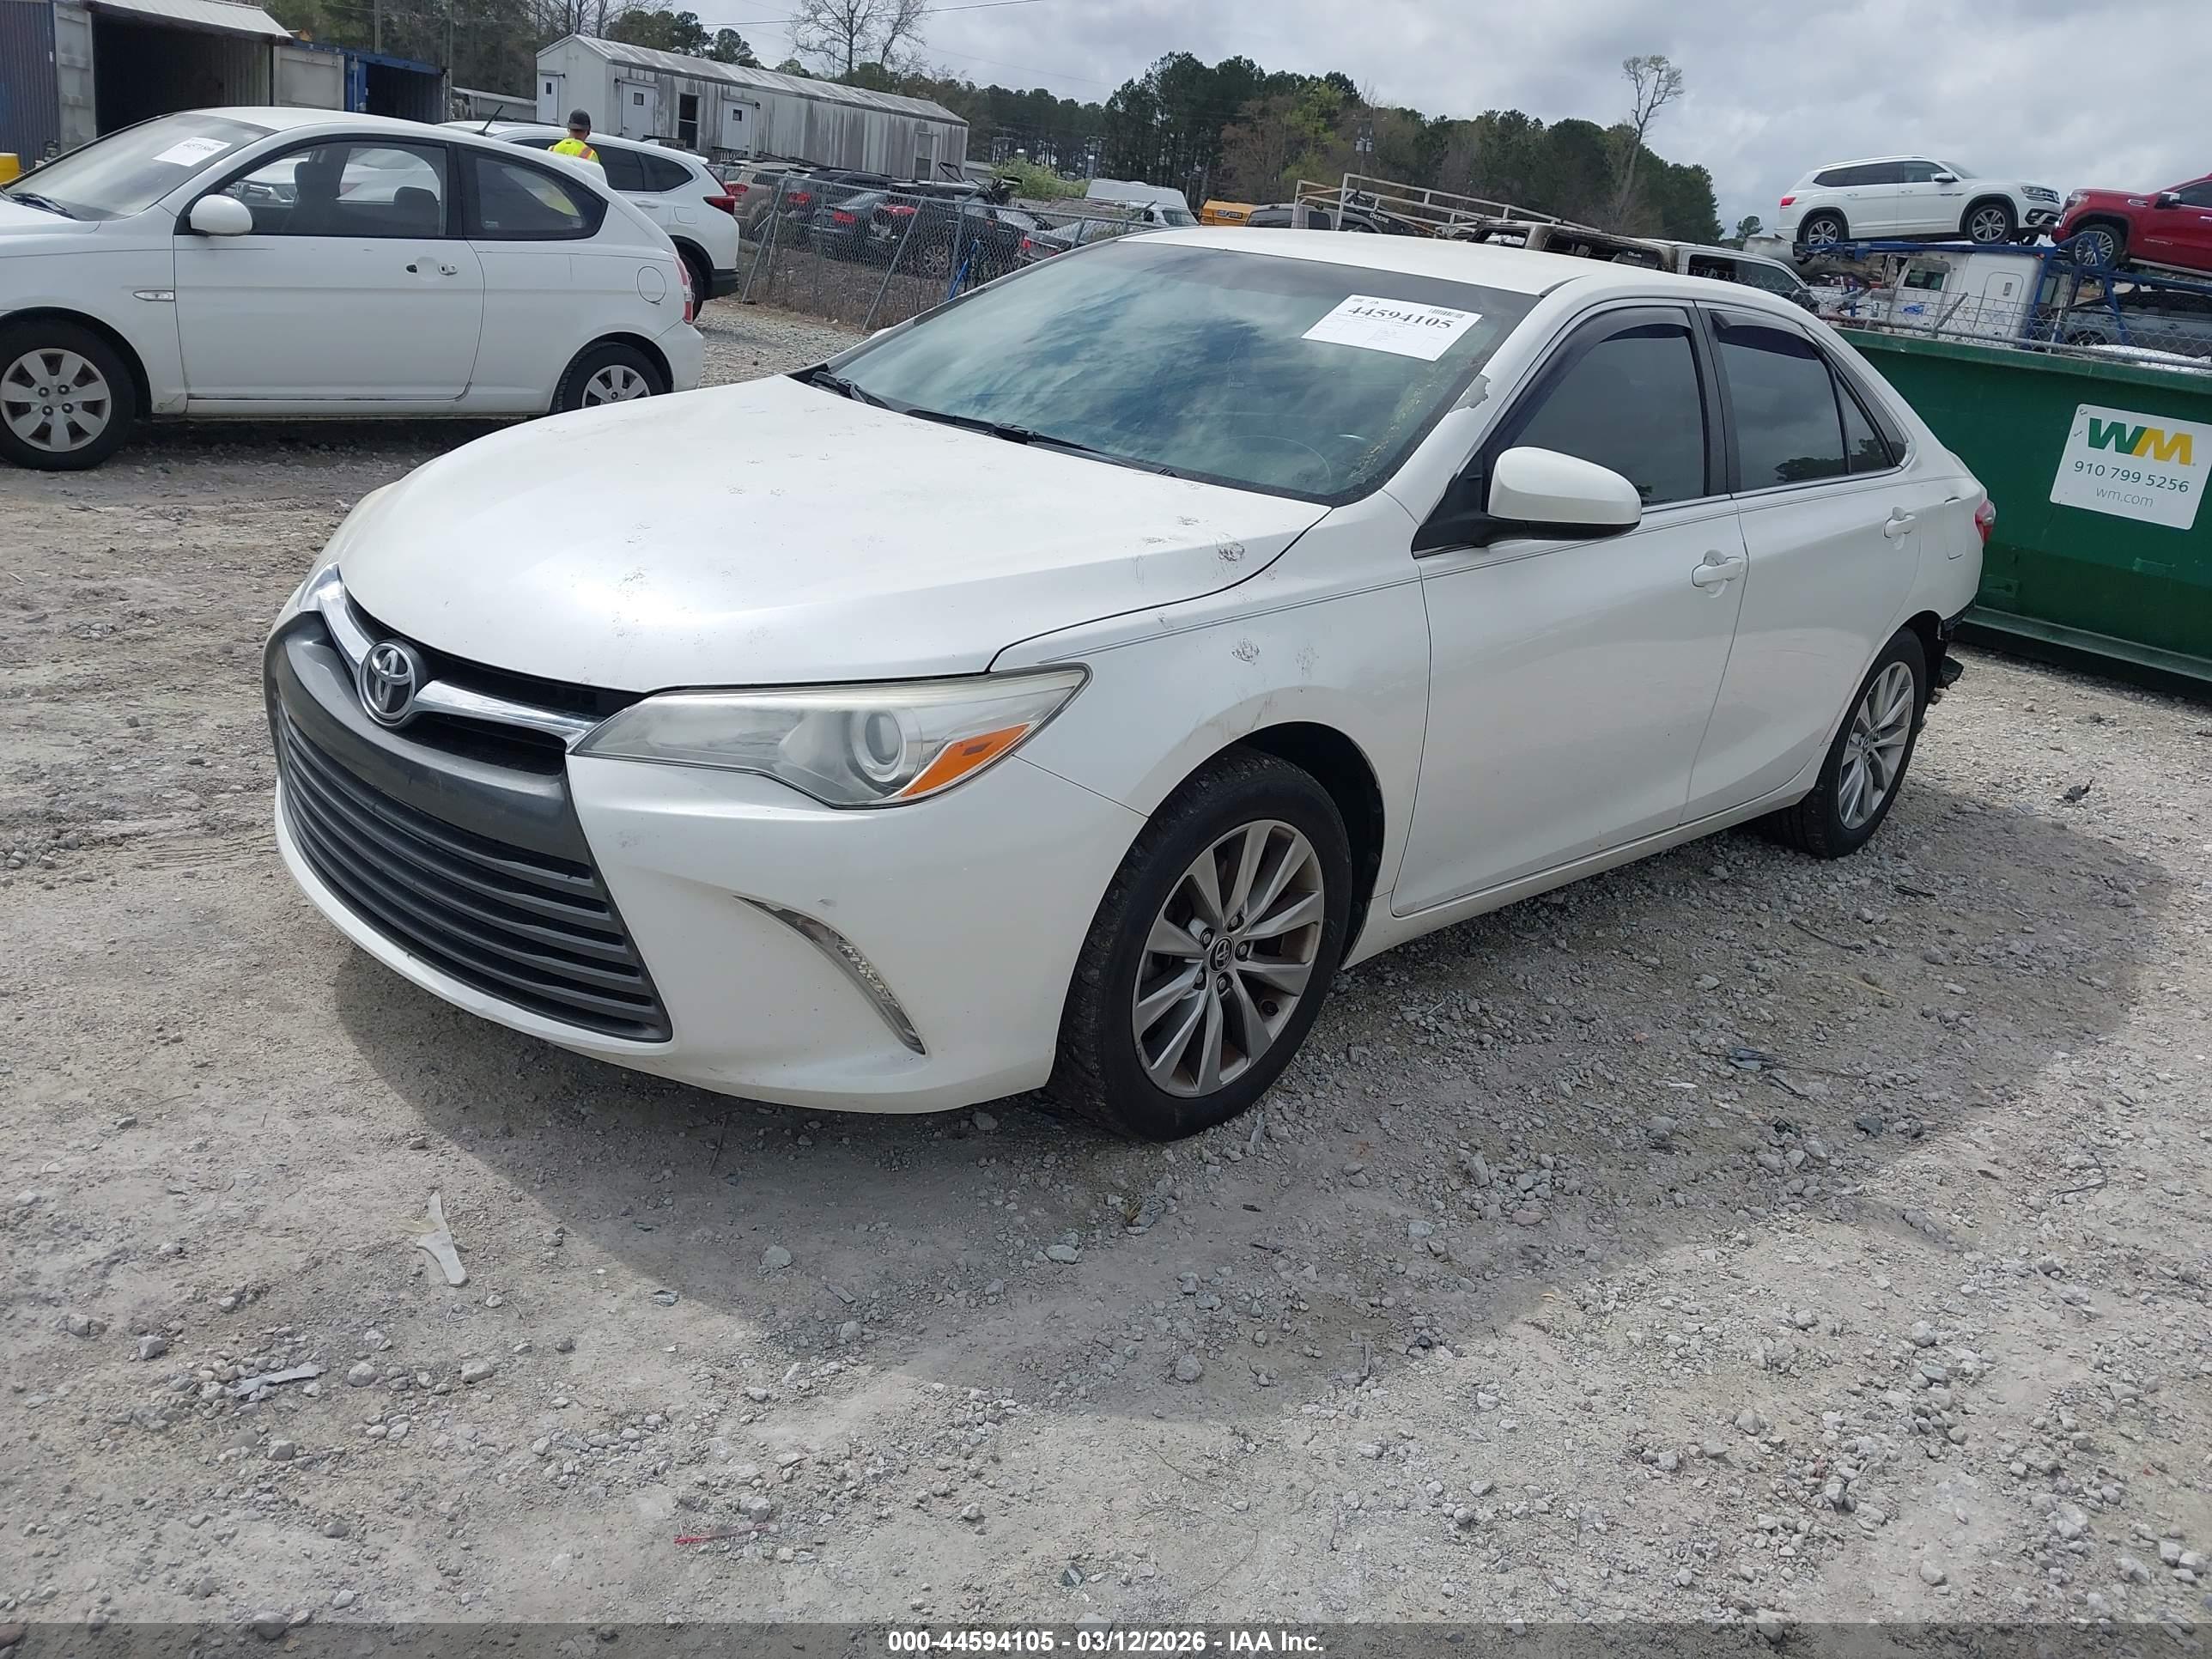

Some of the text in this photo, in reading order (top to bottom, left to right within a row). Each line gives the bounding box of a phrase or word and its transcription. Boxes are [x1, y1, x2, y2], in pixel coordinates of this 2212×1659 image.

[1347, 306, 1456, 330] 44594105
[2087, 417, 2193, 466] WM
[2074, 460, 2191, 493] 910 799 5256
[2096, 487, 2154, 507] wm.com
